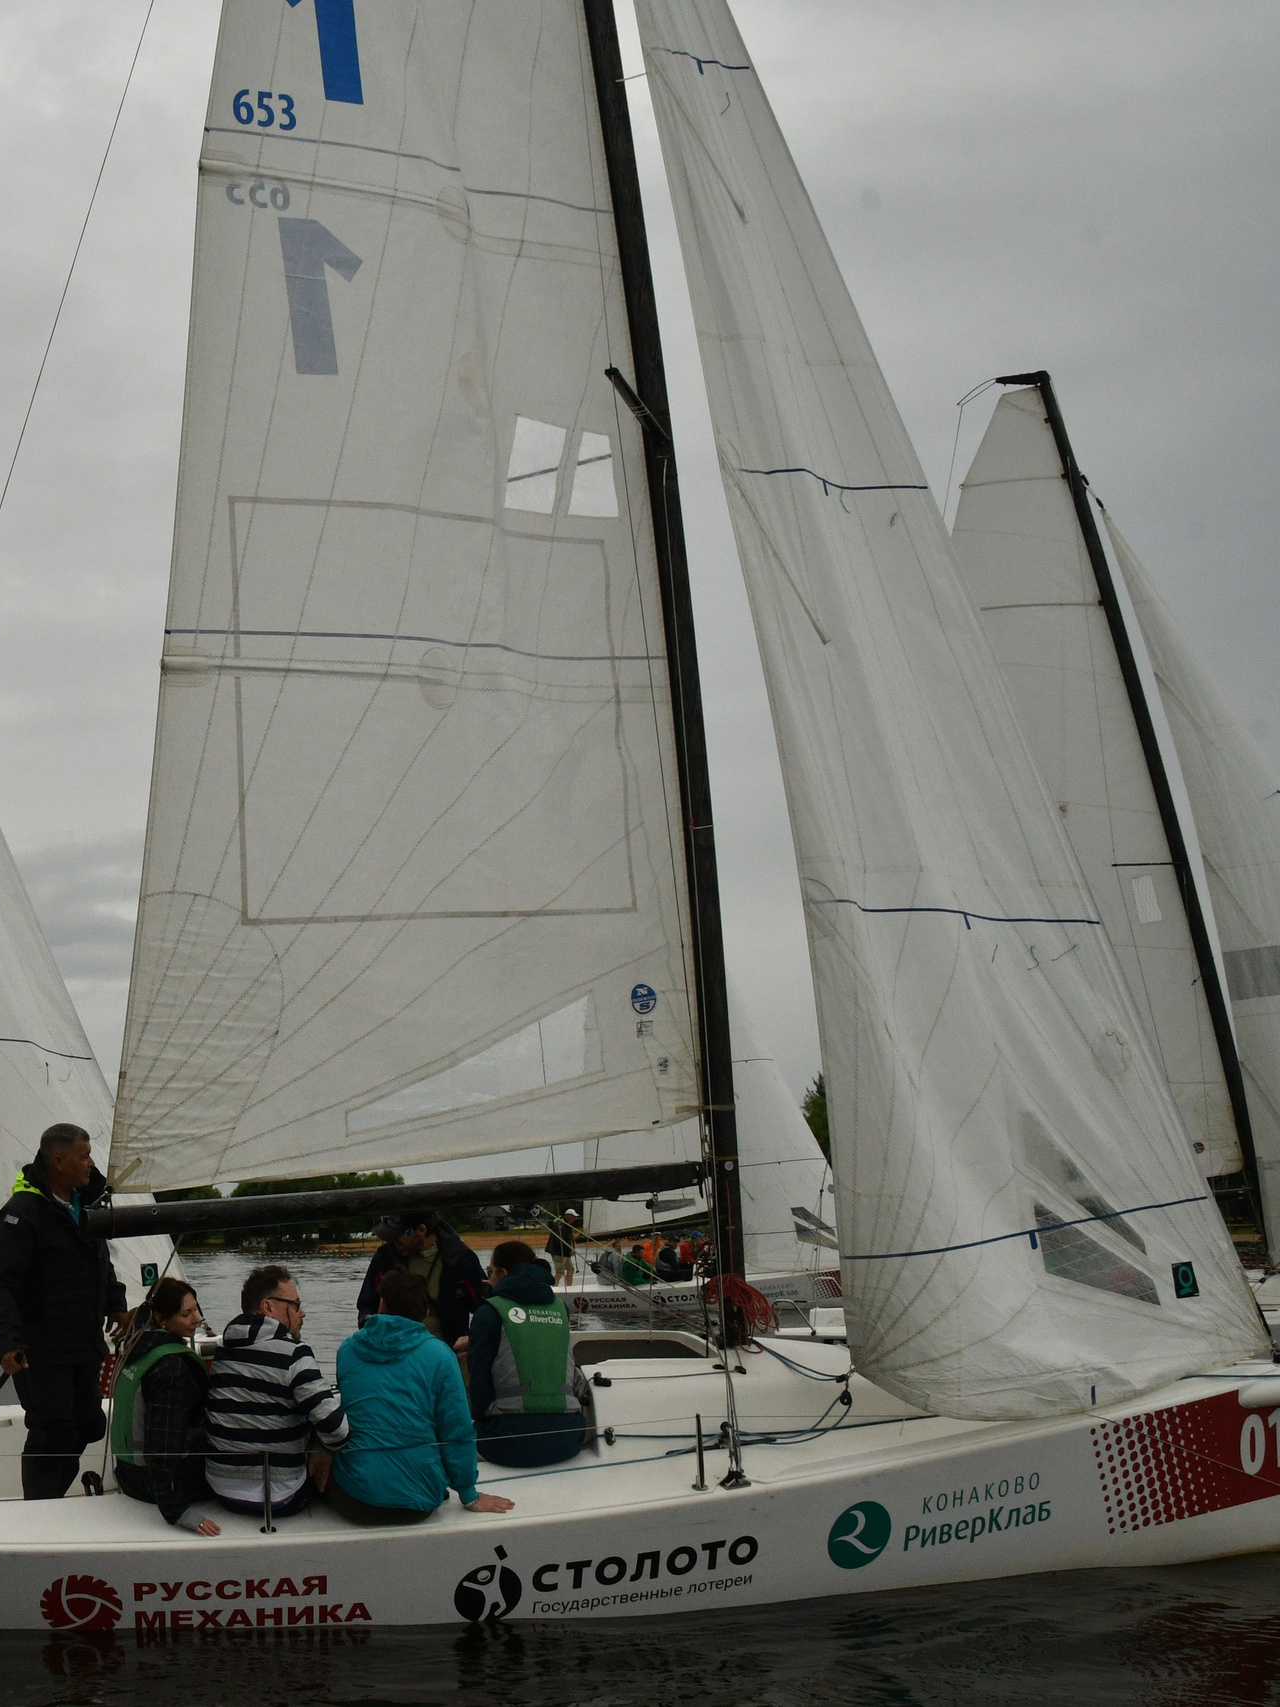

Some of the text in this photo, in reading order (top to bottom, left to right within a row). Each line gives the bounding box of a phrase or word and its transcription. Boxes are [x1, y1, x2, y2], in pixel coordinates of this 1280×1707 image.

[232, 88, 297, 131] 653
[529, 1315, 563, 1325] RiverClub
[589, 1296, 627, 1304] РУССКАЯ
[922, 1472, 1041, 1515] КОНАКОВО
[903, 1500, 1052, 1552] РиверКлаб
[531, 1535, 759, 1593] СТОЛОТО
[133, 1575, 328, 1602] РУССКАЯ
[532, 1574, 753, 1614] Государственные лотереи
[134, 1602, 373, 1631] МЕХАНИКА
